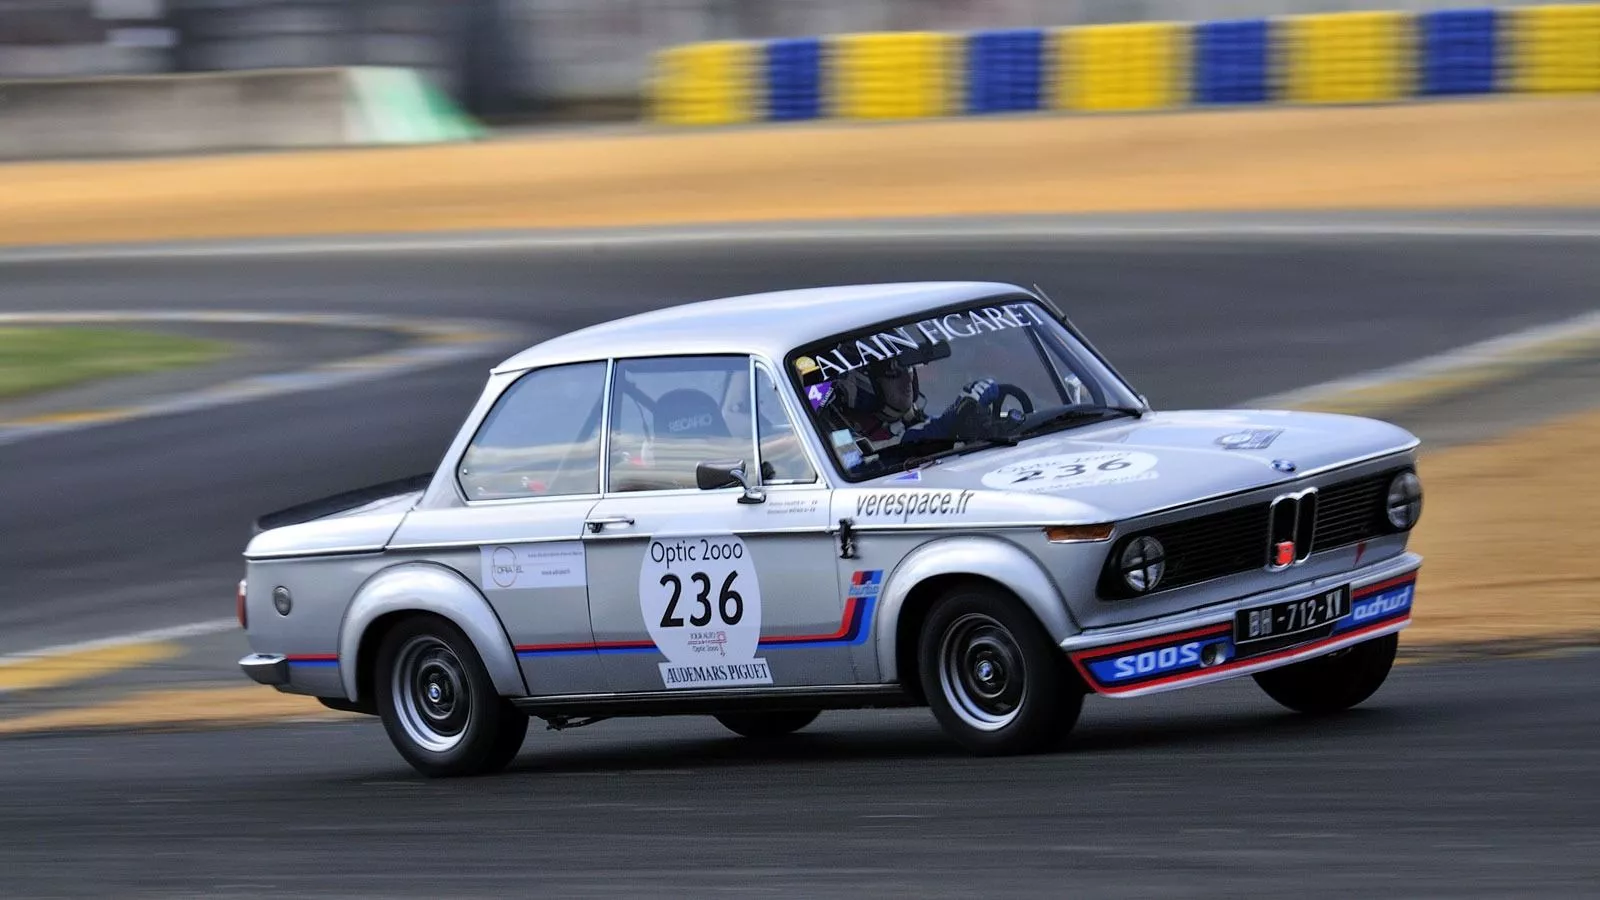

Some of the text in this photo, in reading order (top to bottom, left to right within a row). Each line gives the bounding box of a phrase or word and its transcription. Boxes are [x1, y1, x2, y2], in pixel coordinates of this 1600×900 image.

[816, 303, 1043, 380] ALAIN FIGARET
[808, 385, 823, 401] 4
[1010, 457, 1131, 485] 236
[856, 489, 975, 523] verespace.fr
[651, 539, 743, 569] Optic 2000
[660, 570, 744, 628] 236
[666, 663, 768, 684] AUDEMARS PIGUET
